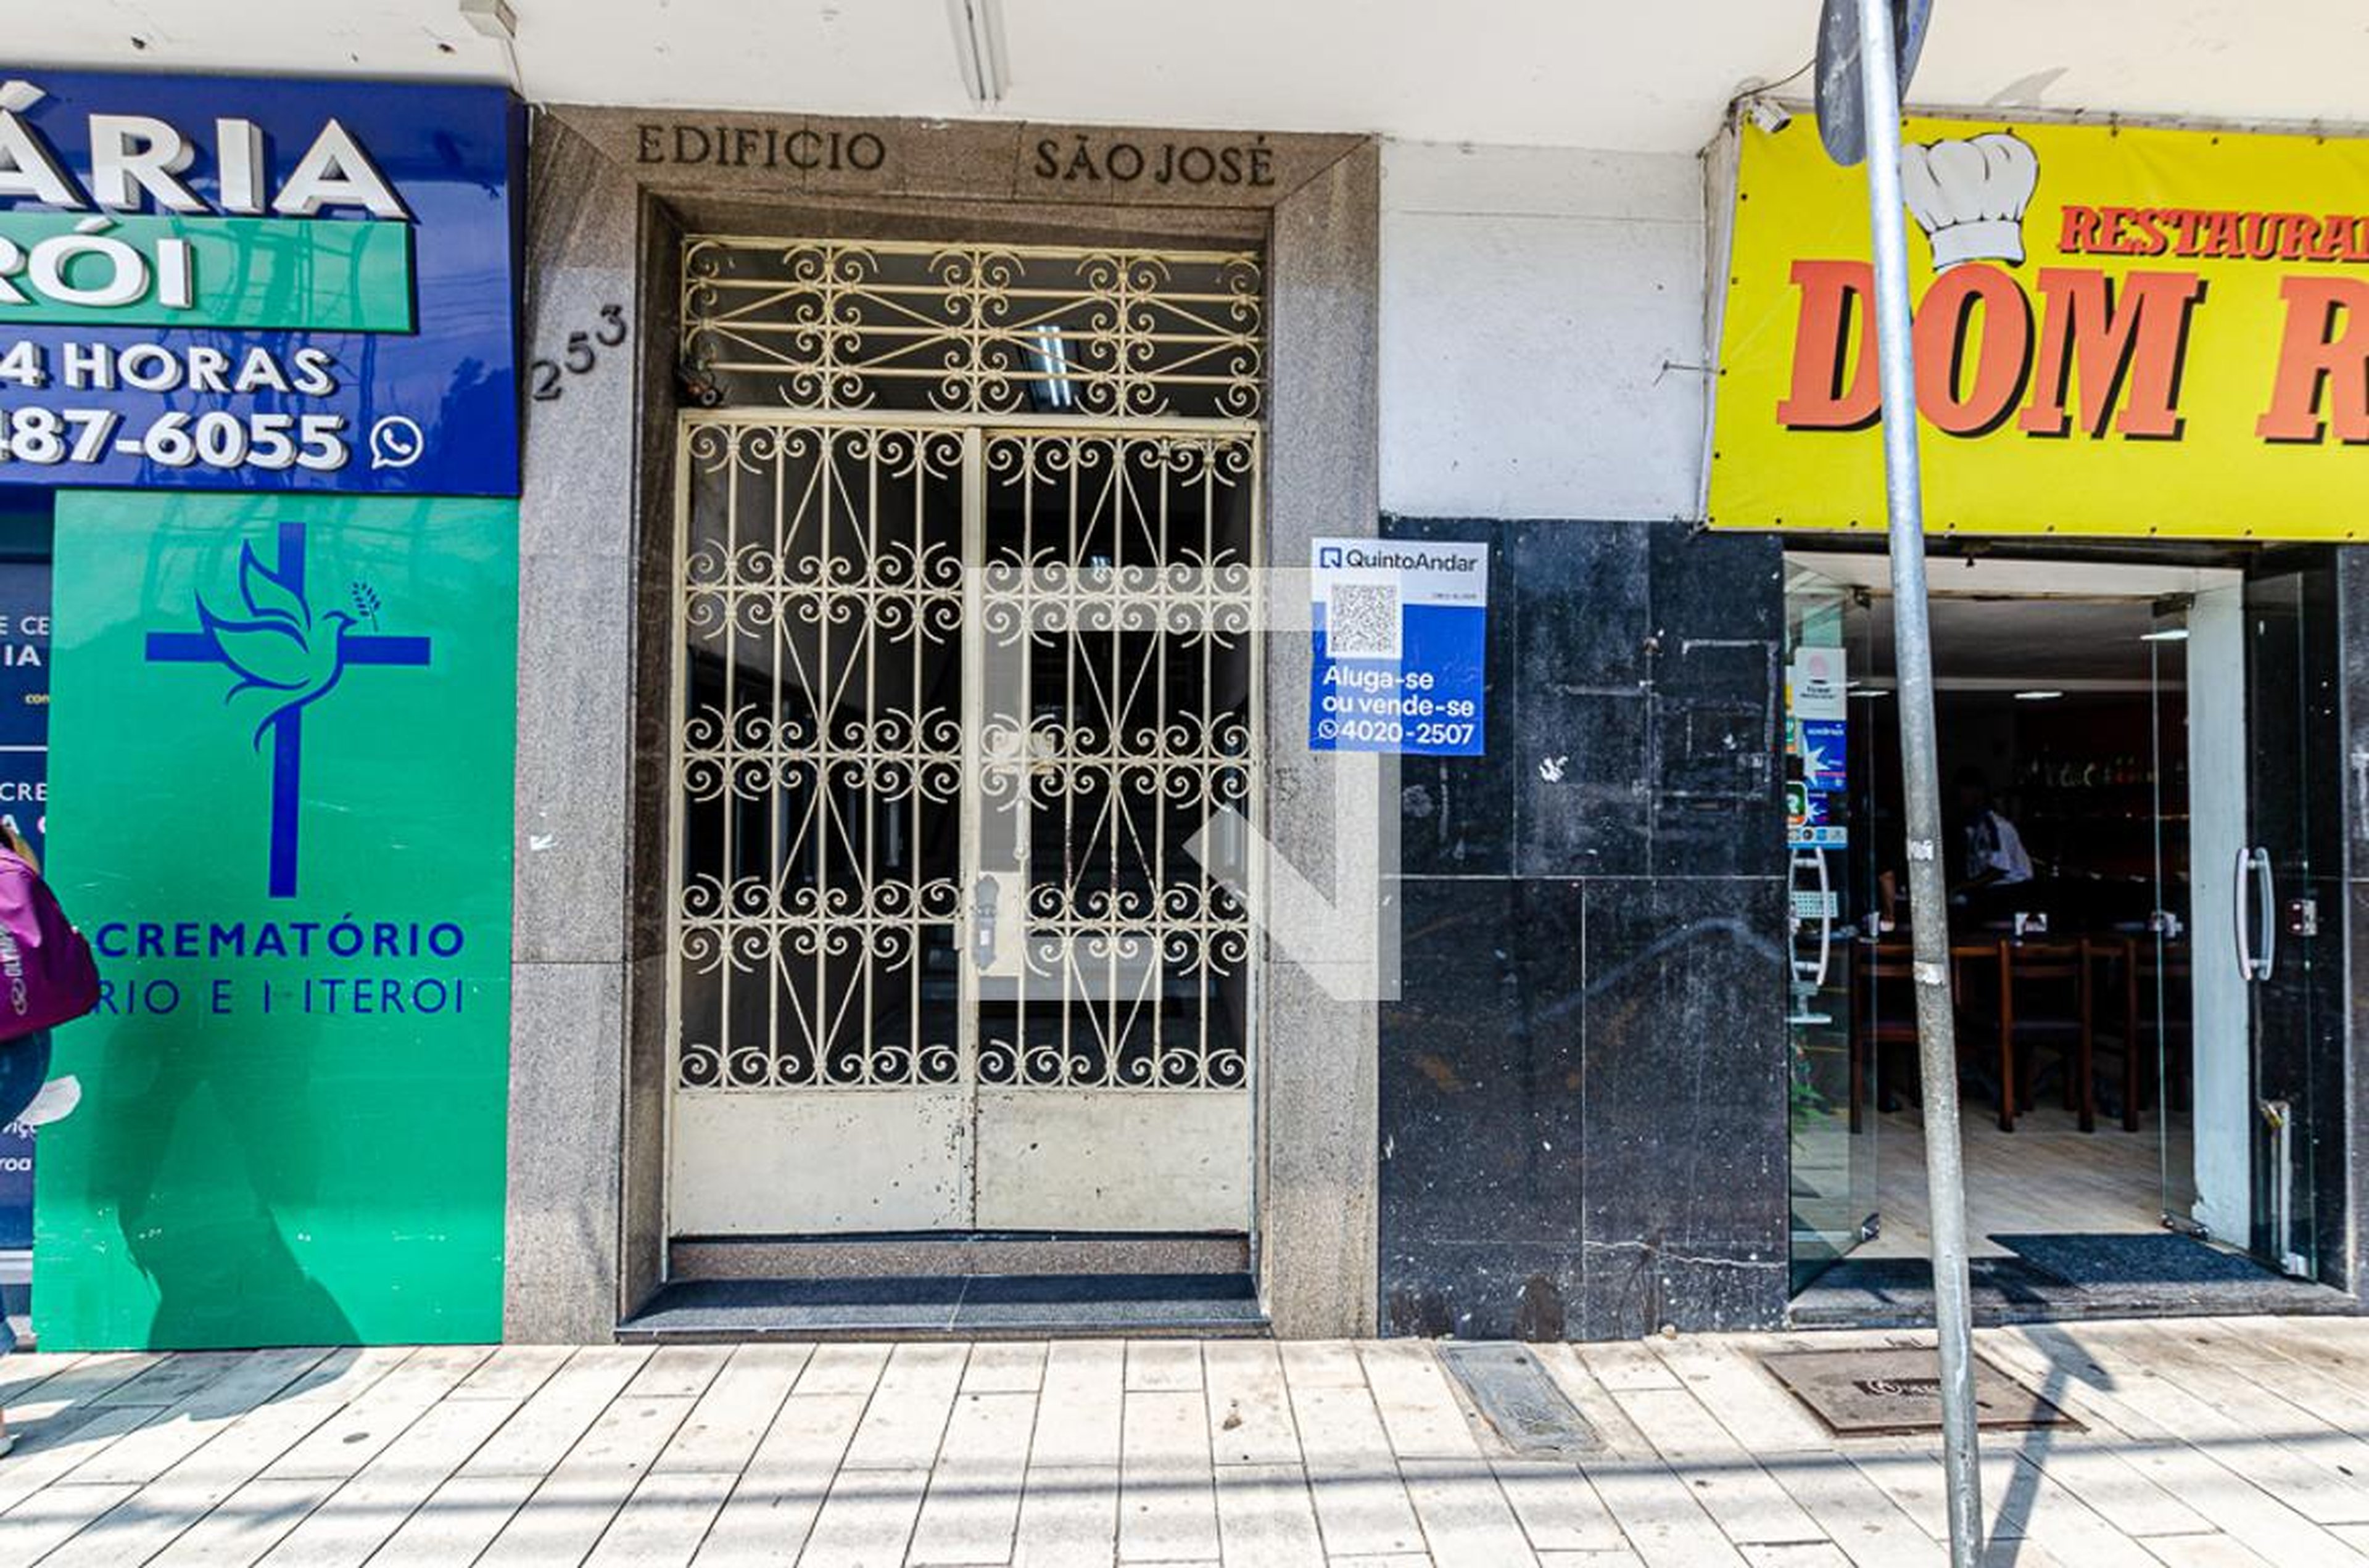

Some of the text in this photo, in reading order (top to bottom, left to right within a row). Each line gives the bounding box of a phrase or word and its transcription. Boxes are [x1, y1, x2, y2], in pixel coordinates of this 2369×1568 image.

[636, 125, 1275, 186] EDIFICIO SÃO JOSÉ
[62, 342, 336, 396] HORAS
[531, 305, 627, 401] 253
[1777, 259, 2207, 442] DOM
[1346, 550, 1479, 572] QuintoAndar
[1323, 666, 1434, 693] Aluga-se
[1322, 695, 1474, 717] ou vende-se
[96, 913, 464, 958] CREMATÓRIO
[212, 980, 231, 1013] E
